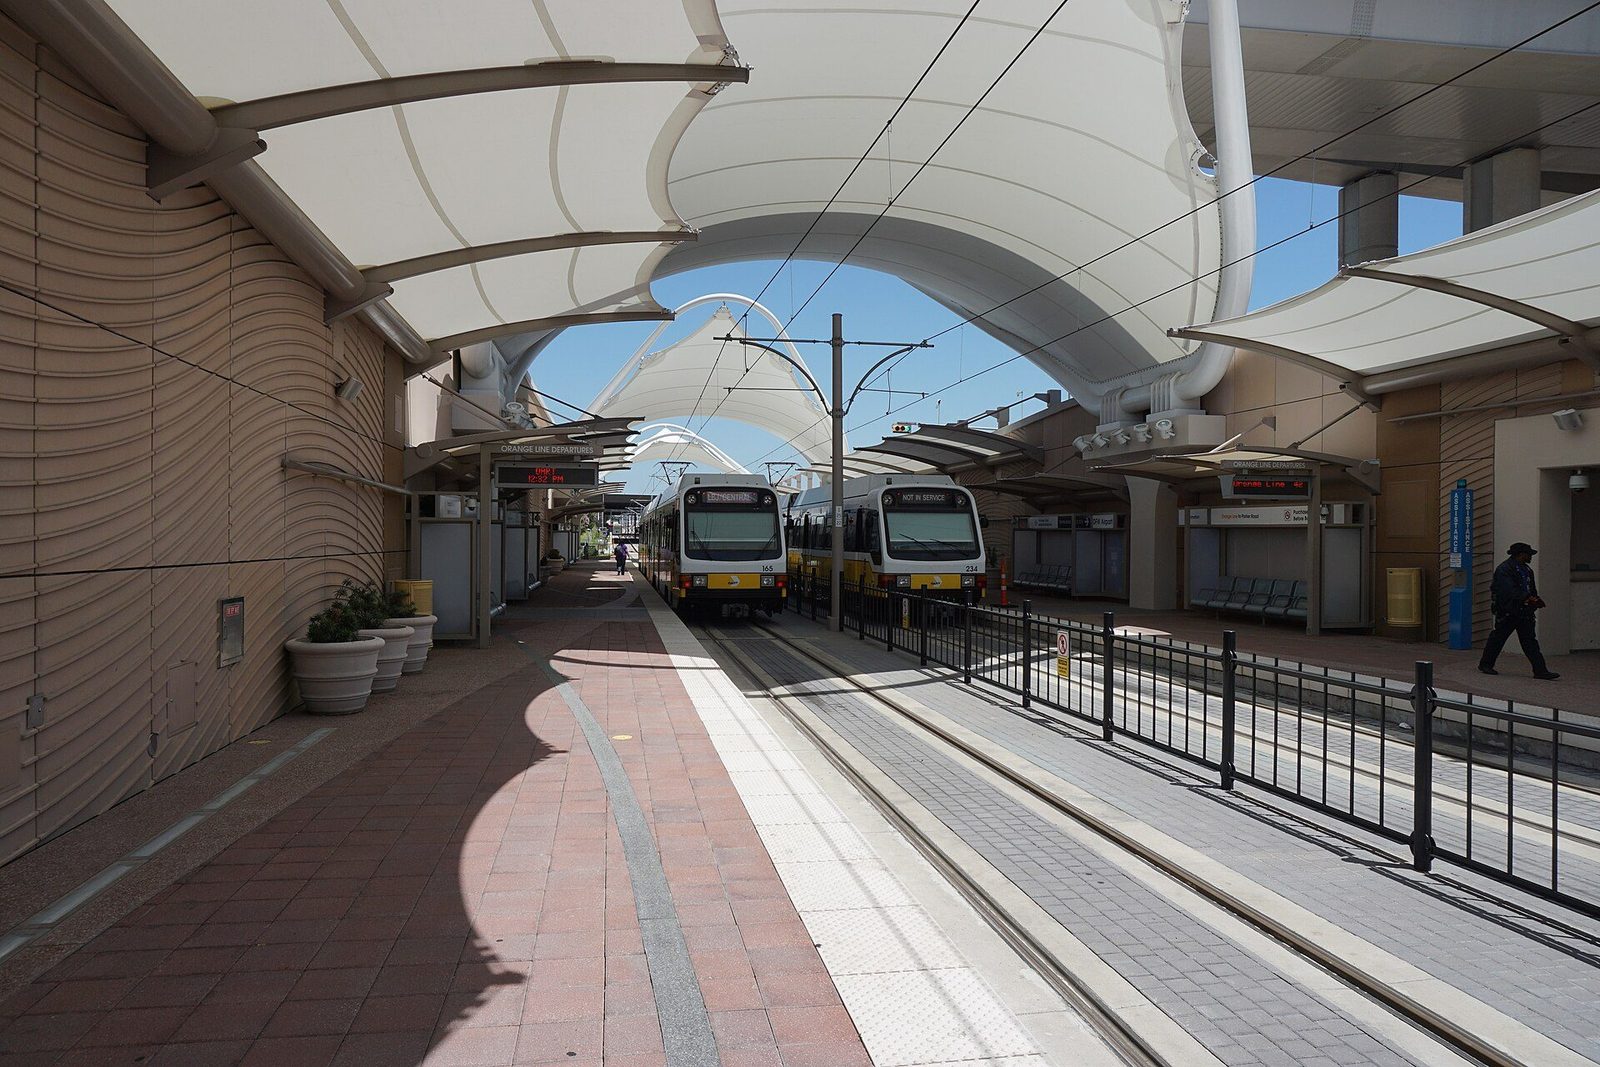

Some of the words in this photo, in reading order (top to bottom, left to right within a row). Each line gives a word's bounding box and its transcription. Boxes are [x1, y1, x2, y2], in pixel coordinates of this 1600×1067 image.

[501, 445, 533, 453] ORANGE
[535, 445, 550, 453] LINE
[551, 446, 594, 454] DEPARTURES
[528, 475, 548, 483] 12:32
[552, 475, 564, 483] PM
[1265, 480, 1285, 488] Line
